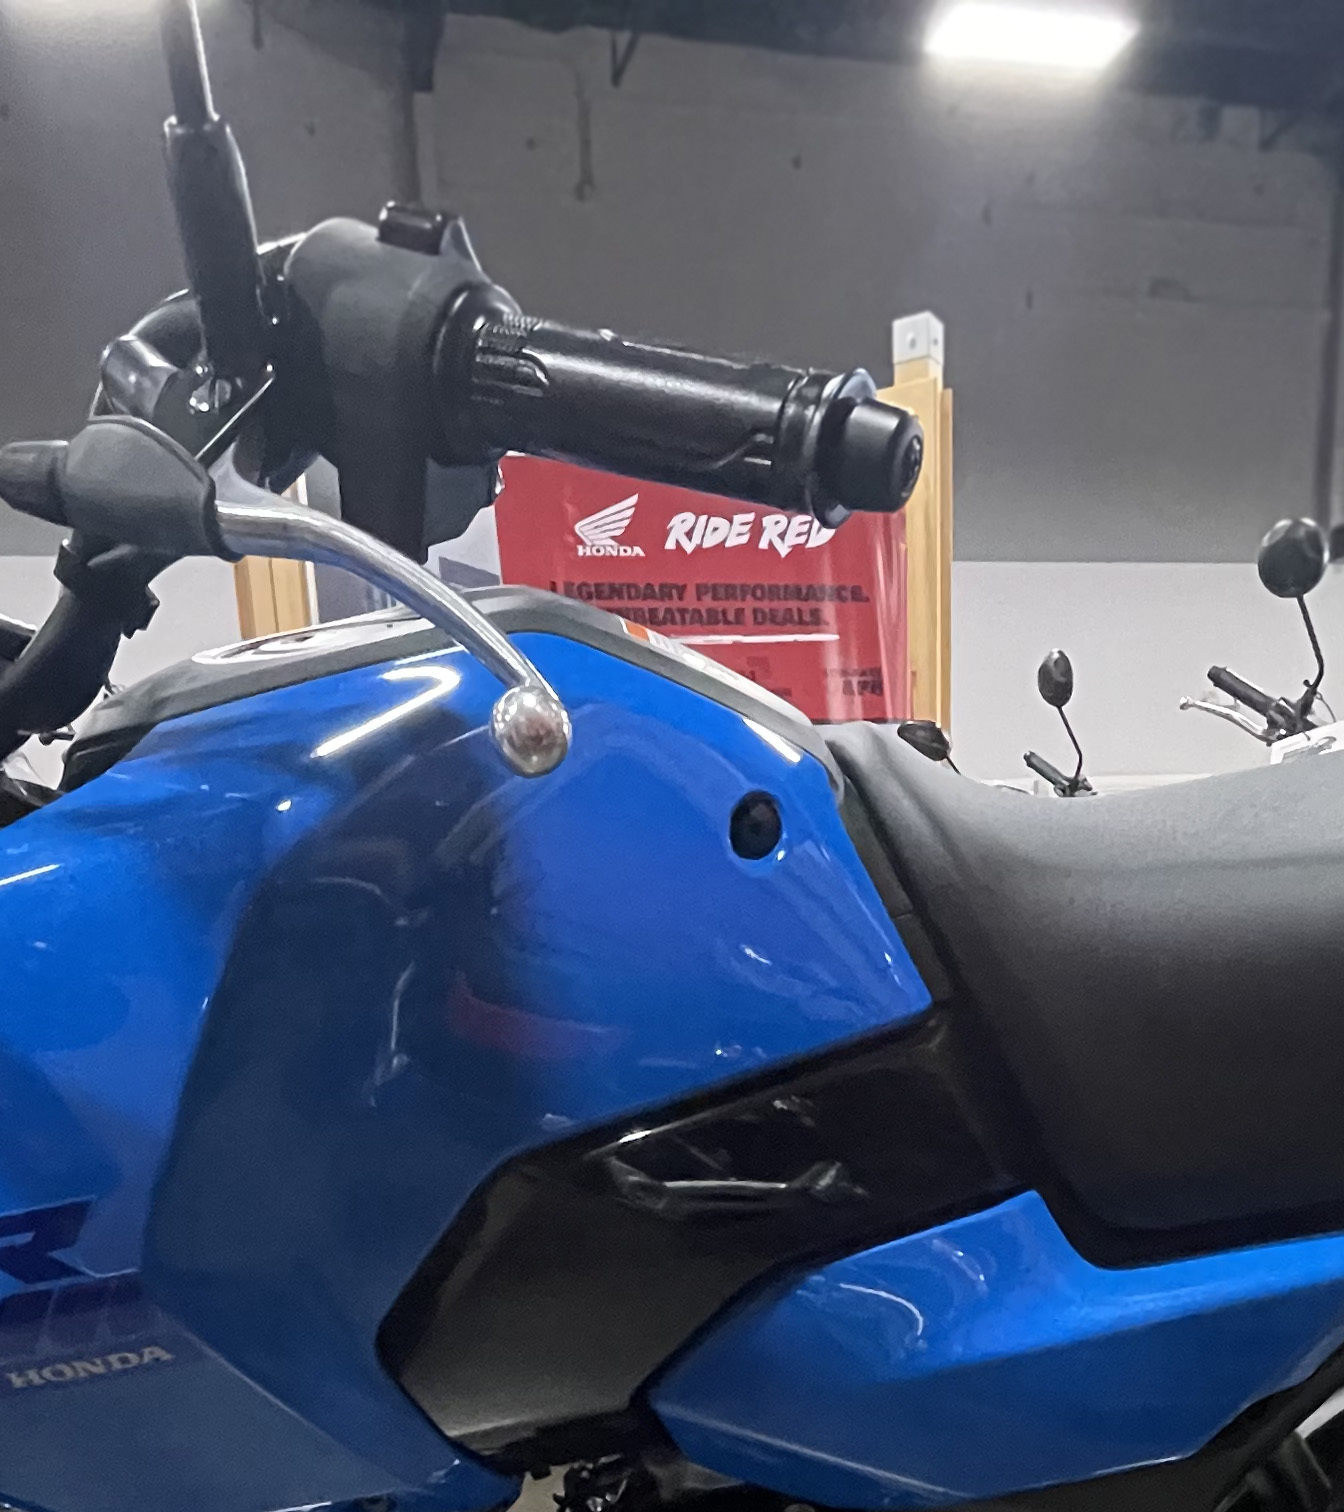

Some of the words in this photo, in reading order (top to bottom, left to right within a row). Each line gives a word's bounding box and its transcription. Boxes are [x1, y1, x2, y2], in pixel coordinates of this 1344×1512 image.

[664, 512, 756, 555] RIDE
[577, 545, 646, 557] HONDA
[600, 606, 745, 626] NBEATABLE
[7, 1346, 174, 1389] HONDA
